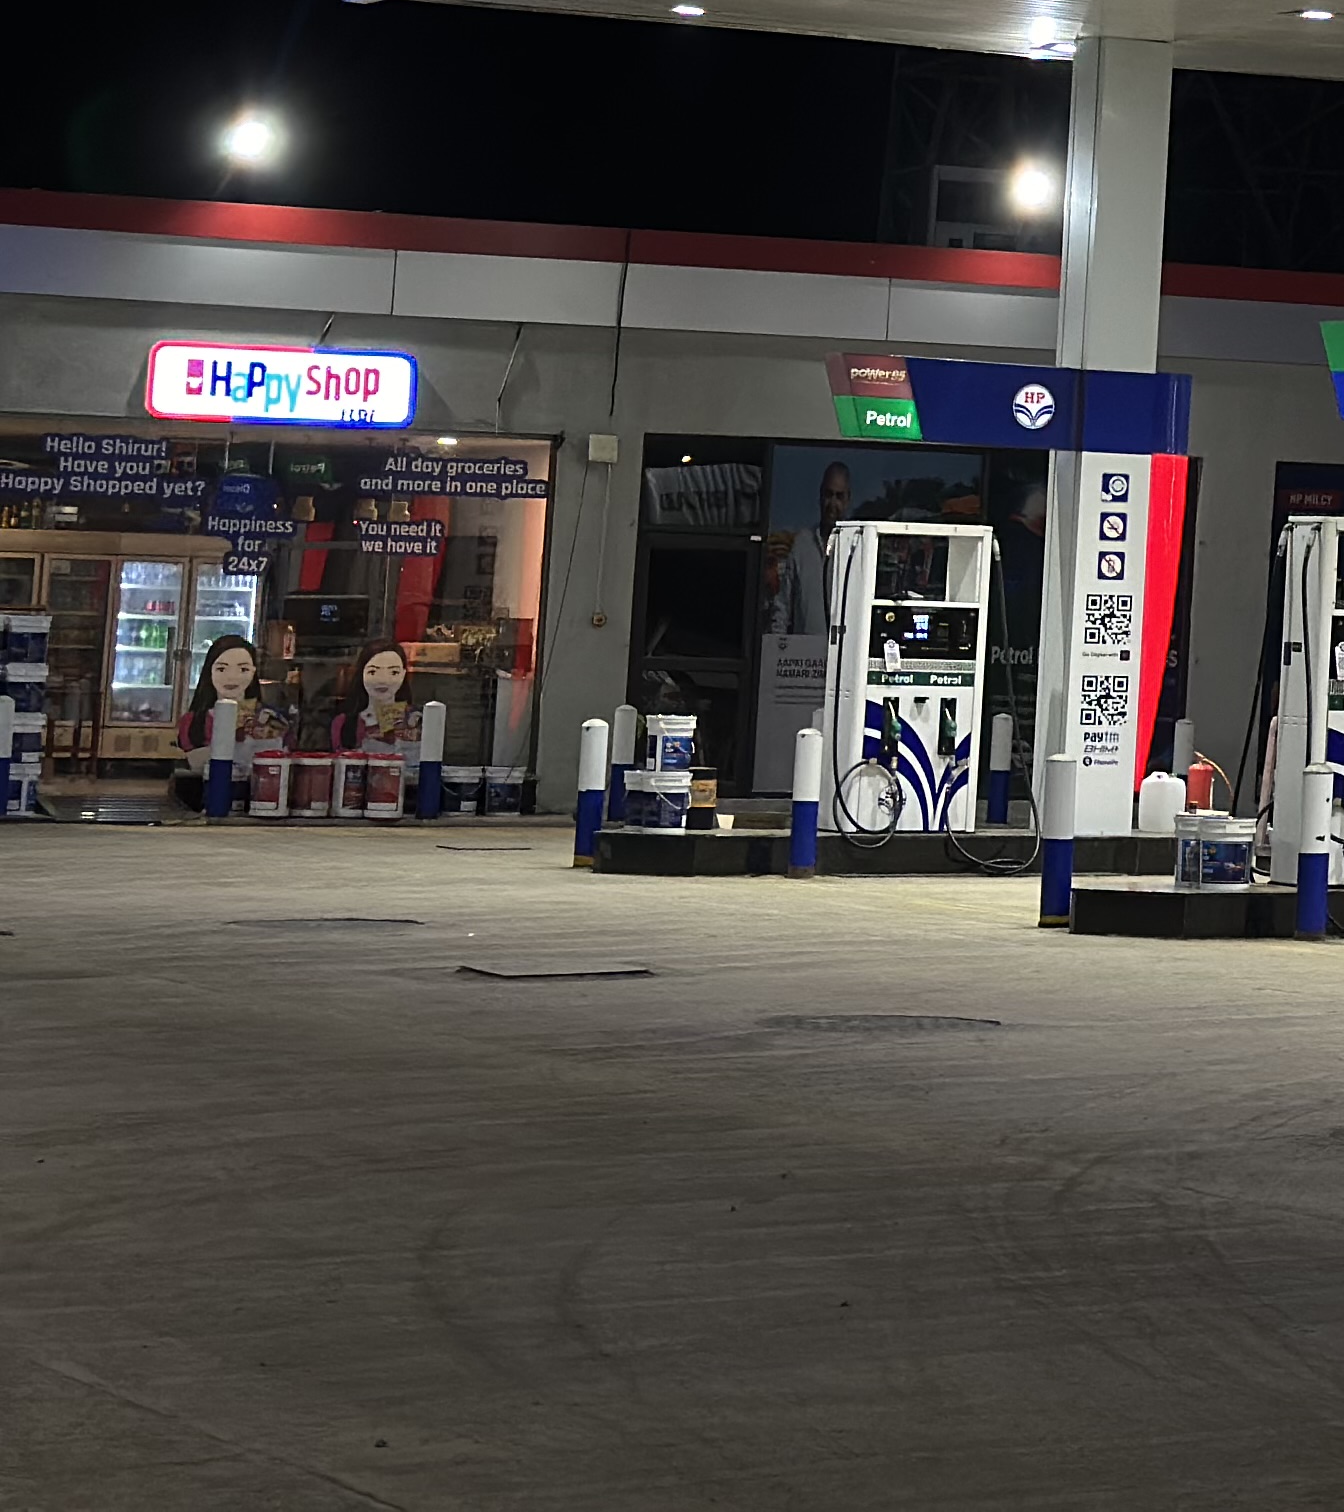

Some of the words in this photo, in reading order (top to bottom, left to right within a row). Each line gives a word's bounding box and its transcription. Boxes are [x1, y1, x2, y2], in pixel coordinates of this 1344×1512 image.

[306, 365, 380, 402] Shop
[1024, 392, 1045, 404] HP
[866, 410, 912, 428] Petrol
[45, 437, 96, 454] Hello
[101, 439, 167, 456] Shirur!
[59, 456, 109, 473] Have
[115, 461, 150, 476] you
[385, 457, 406, 471] All
[411, 458, 442, 476] day
[446, 460, 524, 476] groceries
[0, 473, 64, 494] Happy
[70, 476, 157, 496] Shopped
[163, 480, 206, 497] yet?
[360, 476, 393, 490] and
[397, 480, 441, 491] more
[446, 479, 461, 492] in
[466, 482, 497, 494] one
[501, 480, 546, 496] place
[208, 516, 294, 533] Happiness
[360, 521, 389, 535] You
[391, 522, 428, 536] need
[431, 523, 442, 537] it
[238, 537, 262, 552] for
[362, 541, 383, 552] we
[387, 539, 422, 553] have
[426, 540, 438, 553] it
[228, 556, 268, 572] 24x7
[881, 674, 914, 683] Petrol
[930, 675, 962, 685] Petrol
